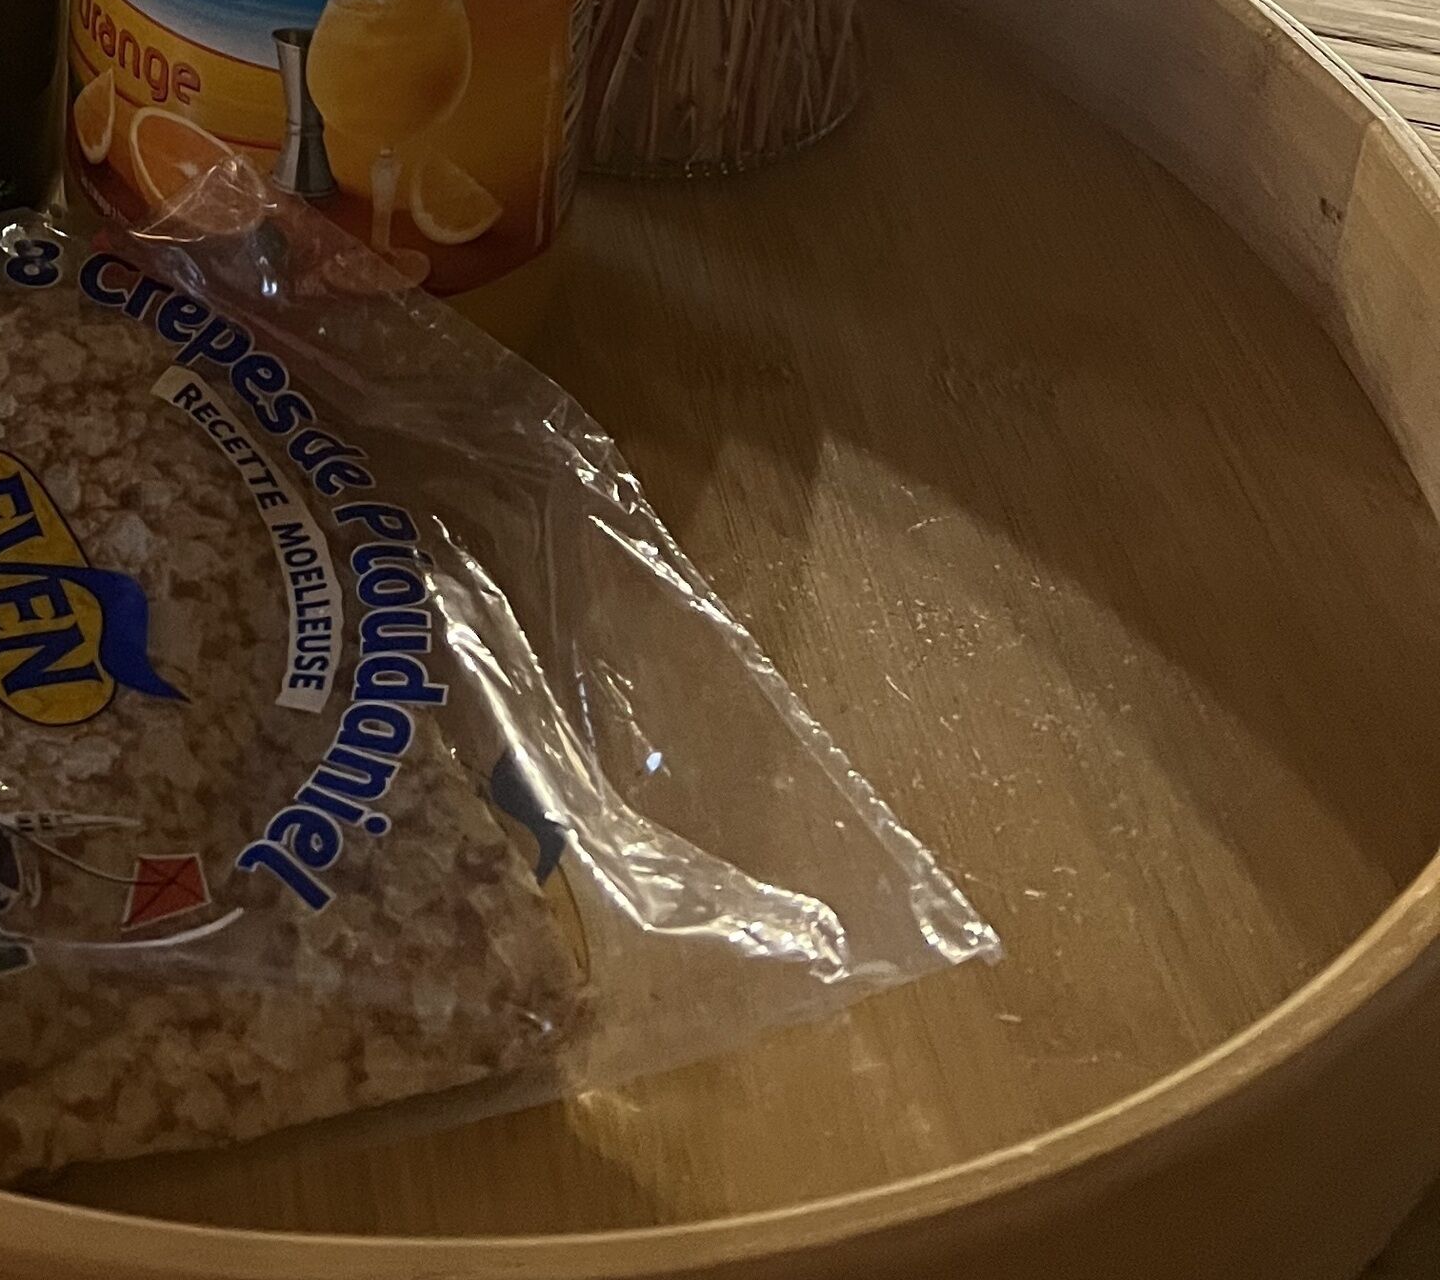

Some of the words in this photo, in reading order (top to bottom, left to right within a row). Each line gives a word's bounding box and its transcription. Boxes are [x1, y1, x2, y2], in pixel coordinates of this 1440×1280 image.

[5, 240, 61, 288] 8
[173, 382, 291, 511] RECETTE
[271, 521, 332, 692] MOELLEUSE
